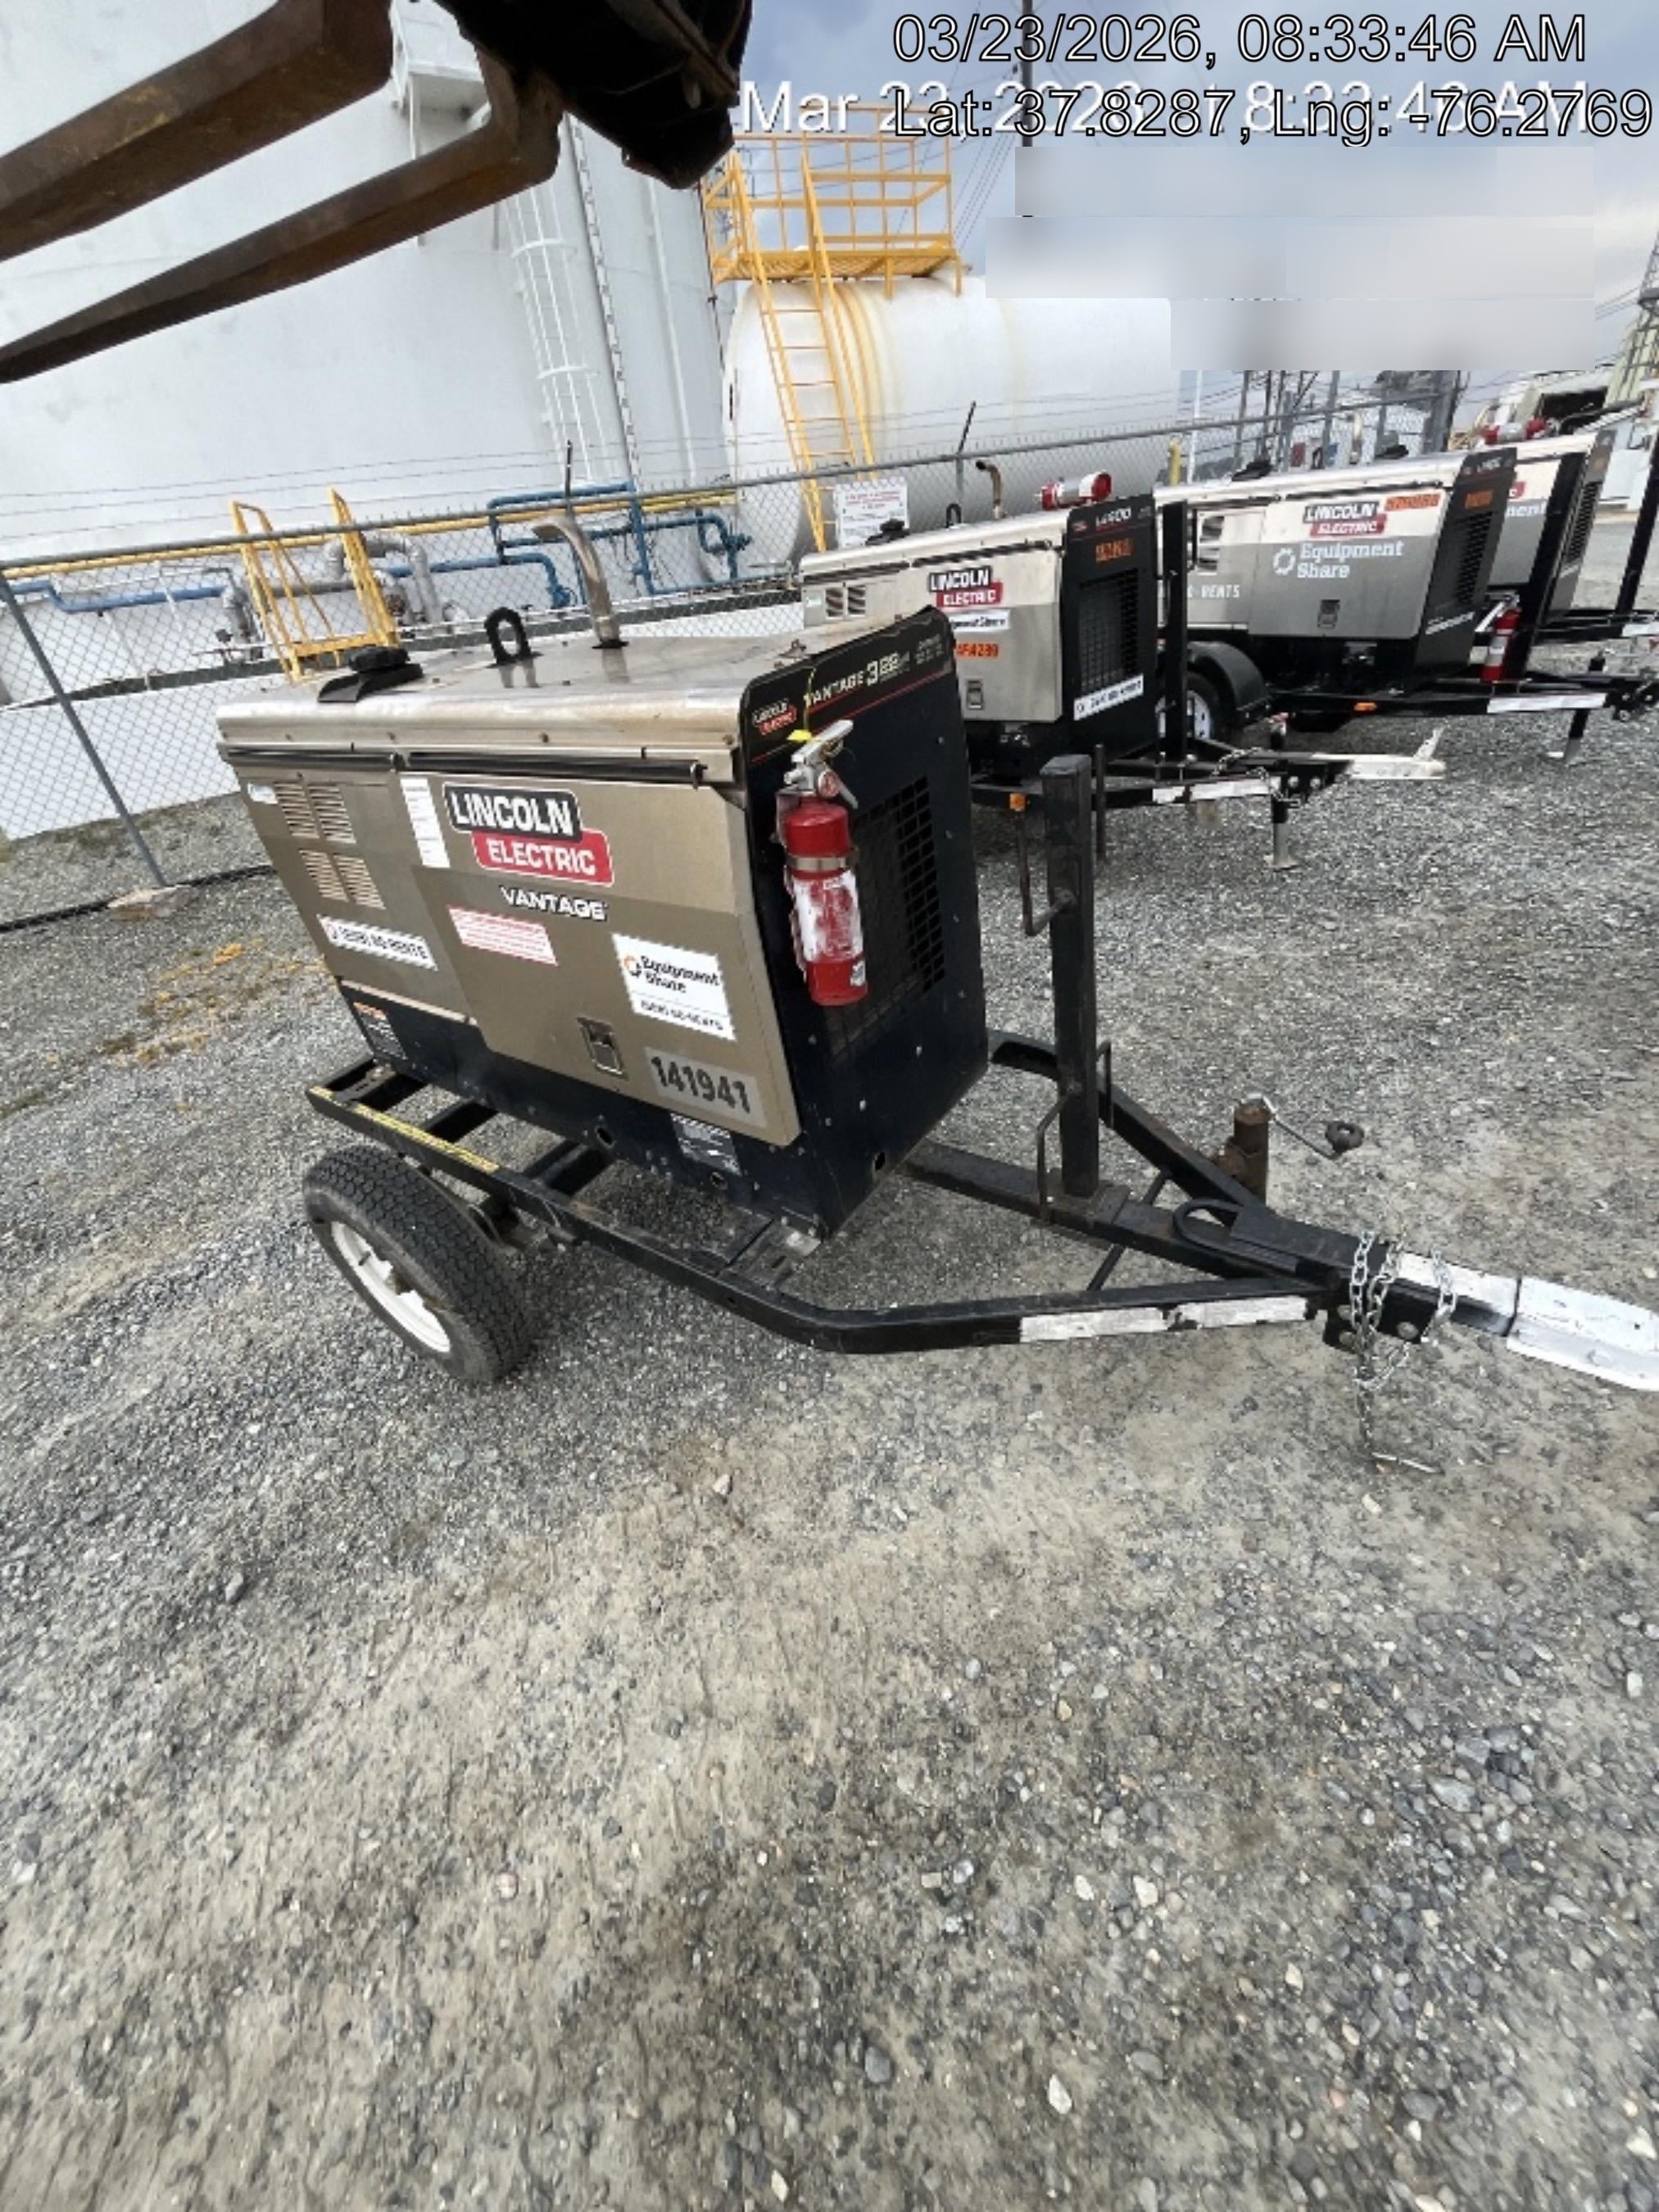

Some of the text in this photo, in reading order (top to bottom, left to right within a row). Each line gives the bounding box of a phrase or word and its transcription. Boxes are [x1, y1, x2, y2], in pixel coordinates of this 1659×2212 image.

[1306, 503, 1376, 522] LINCOLN
[1299, 540, 1405, 564] Equipment
[930, 568, 990, 591] LINCOLN
[1297, 561, 1351, 578] Share
[942, 589, 997, 605] ELECTRIC
[451, 791, 574, 836] LINCOLN
[486, 837, 596, 876] ELECTRIC
[500, 884, 608, 922] VANTAGE
[641, 954, 721, 986] Equipment
[645, 972, 687, 994] Share
[650, 1055, 750, 1115] 141941
